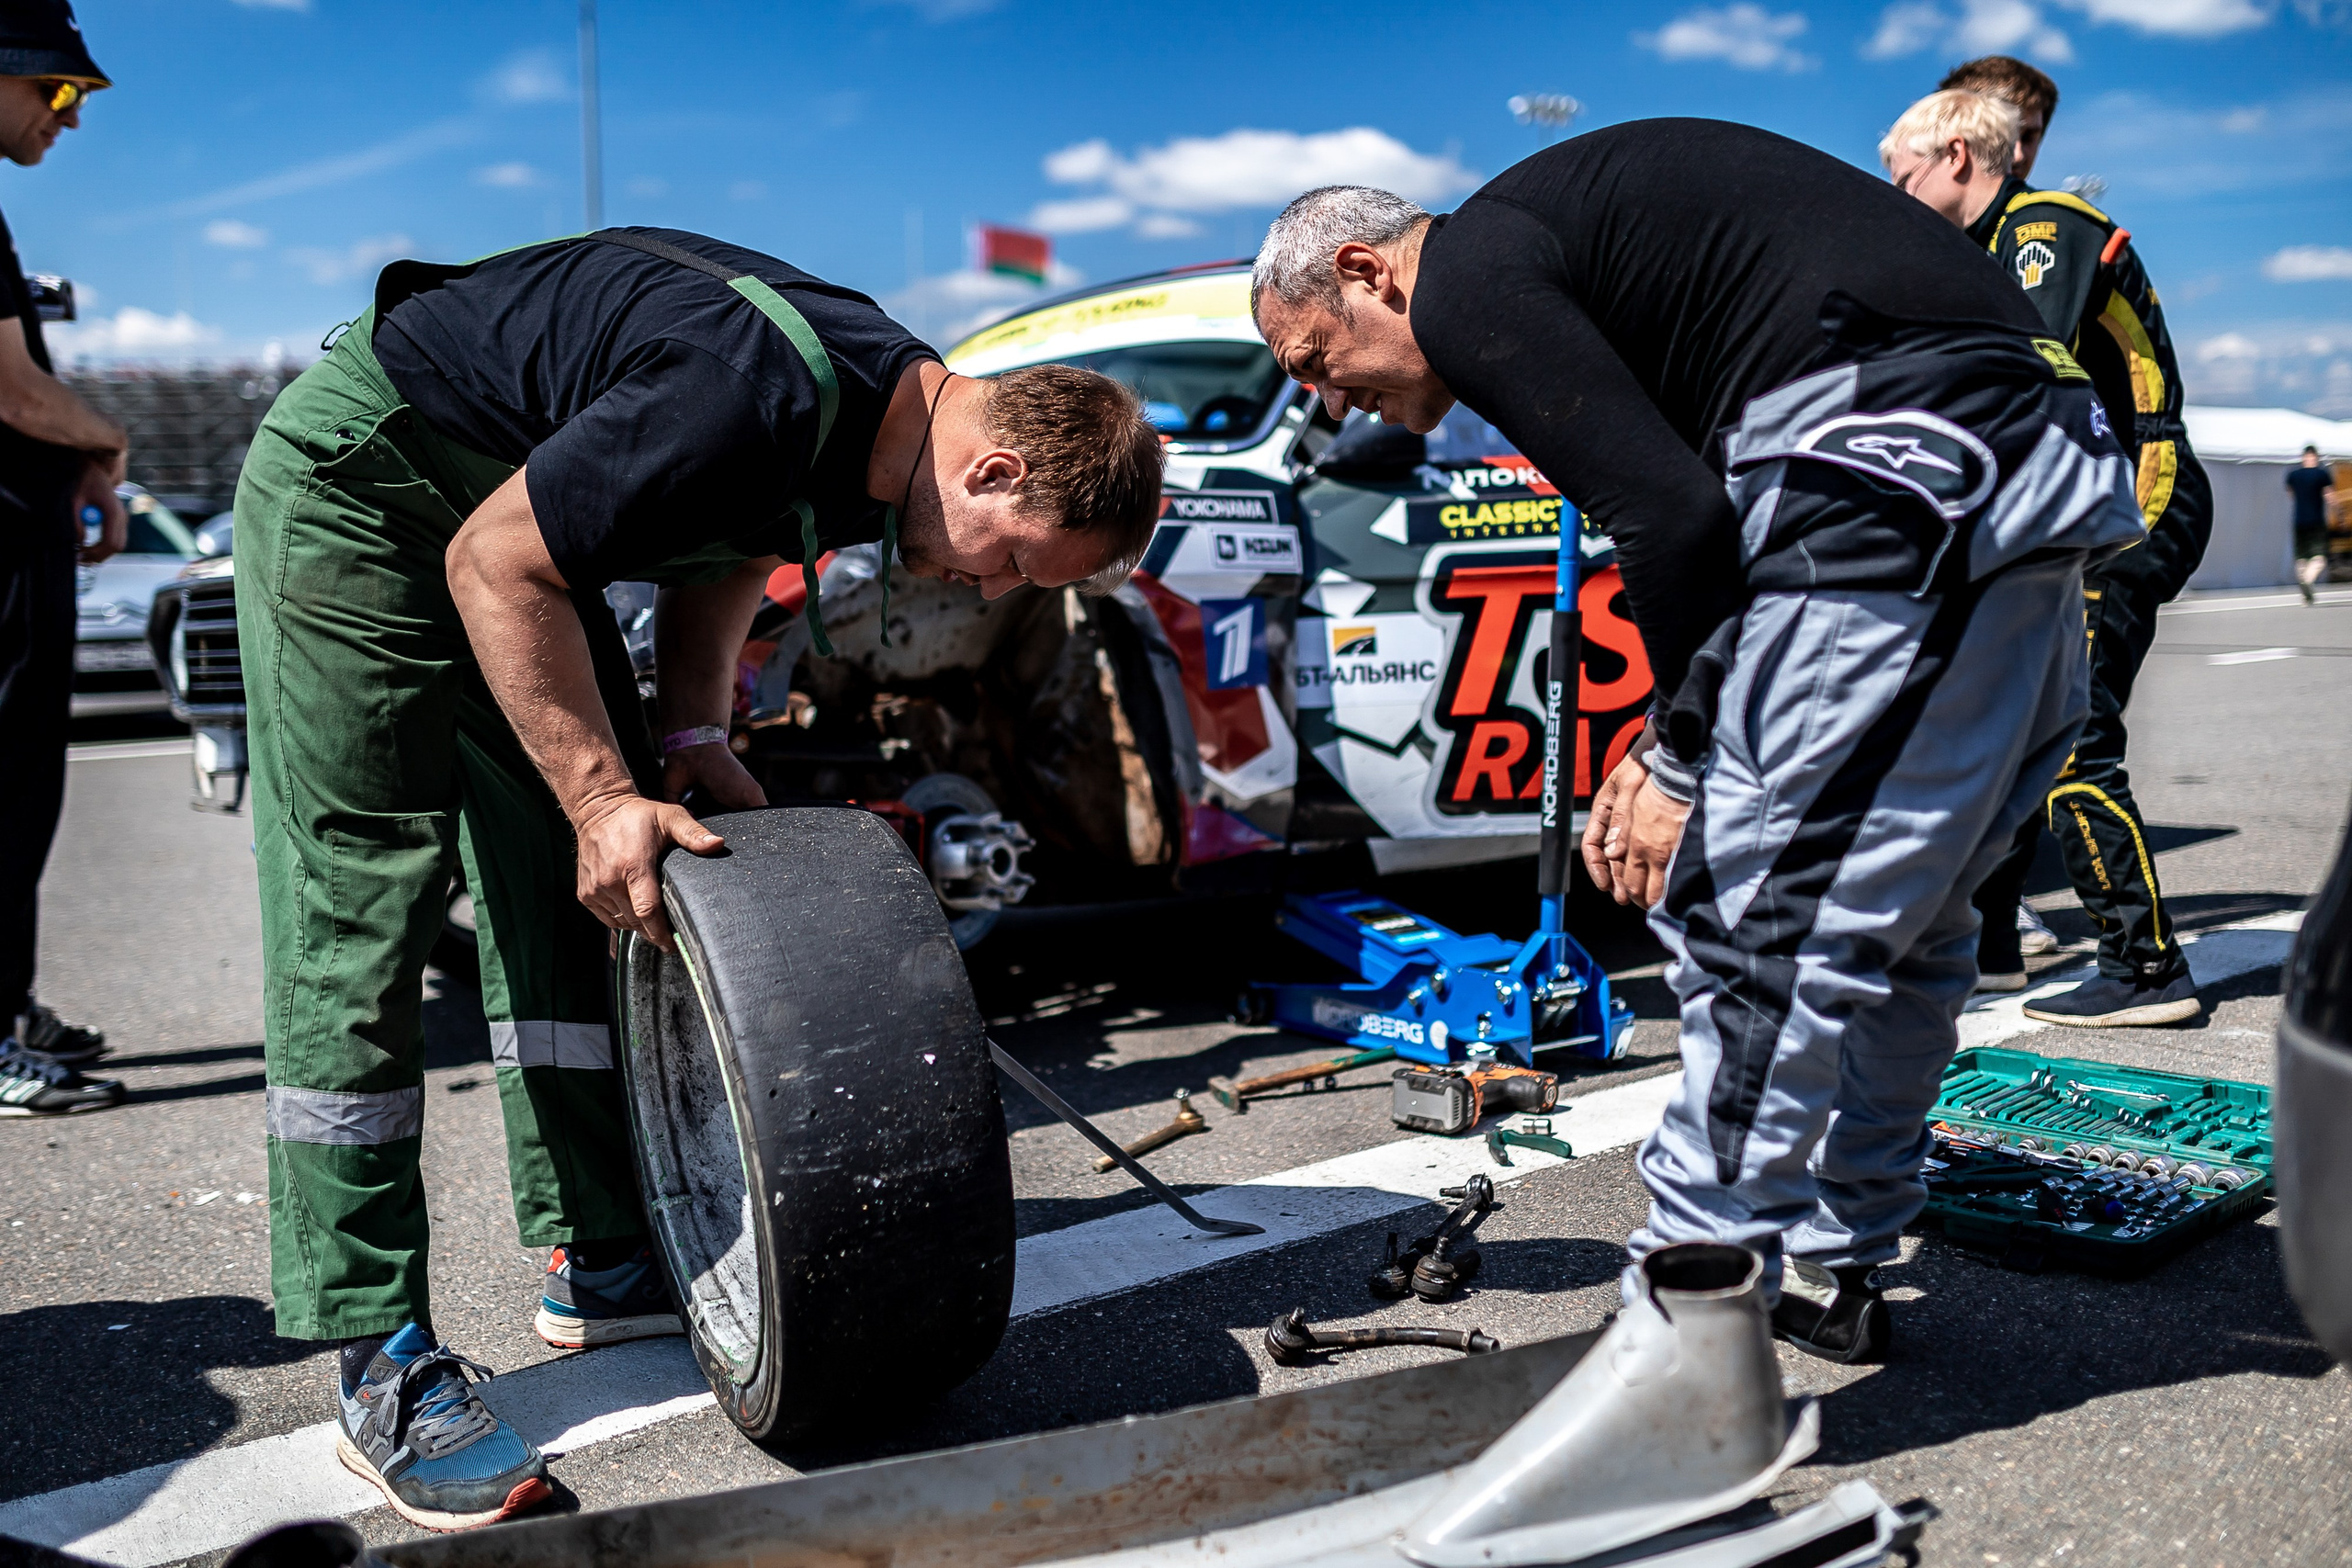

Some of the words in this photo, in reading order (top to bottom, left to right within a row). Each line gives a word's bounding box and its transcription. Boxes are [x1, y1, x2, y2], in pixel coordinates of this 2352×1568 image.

[1172, 497, 1268, 519] YOKOHAMA
[1440, 499, 1563, 528] CLASSIC
[1543, 681, 1563, 828] NORDBERG
